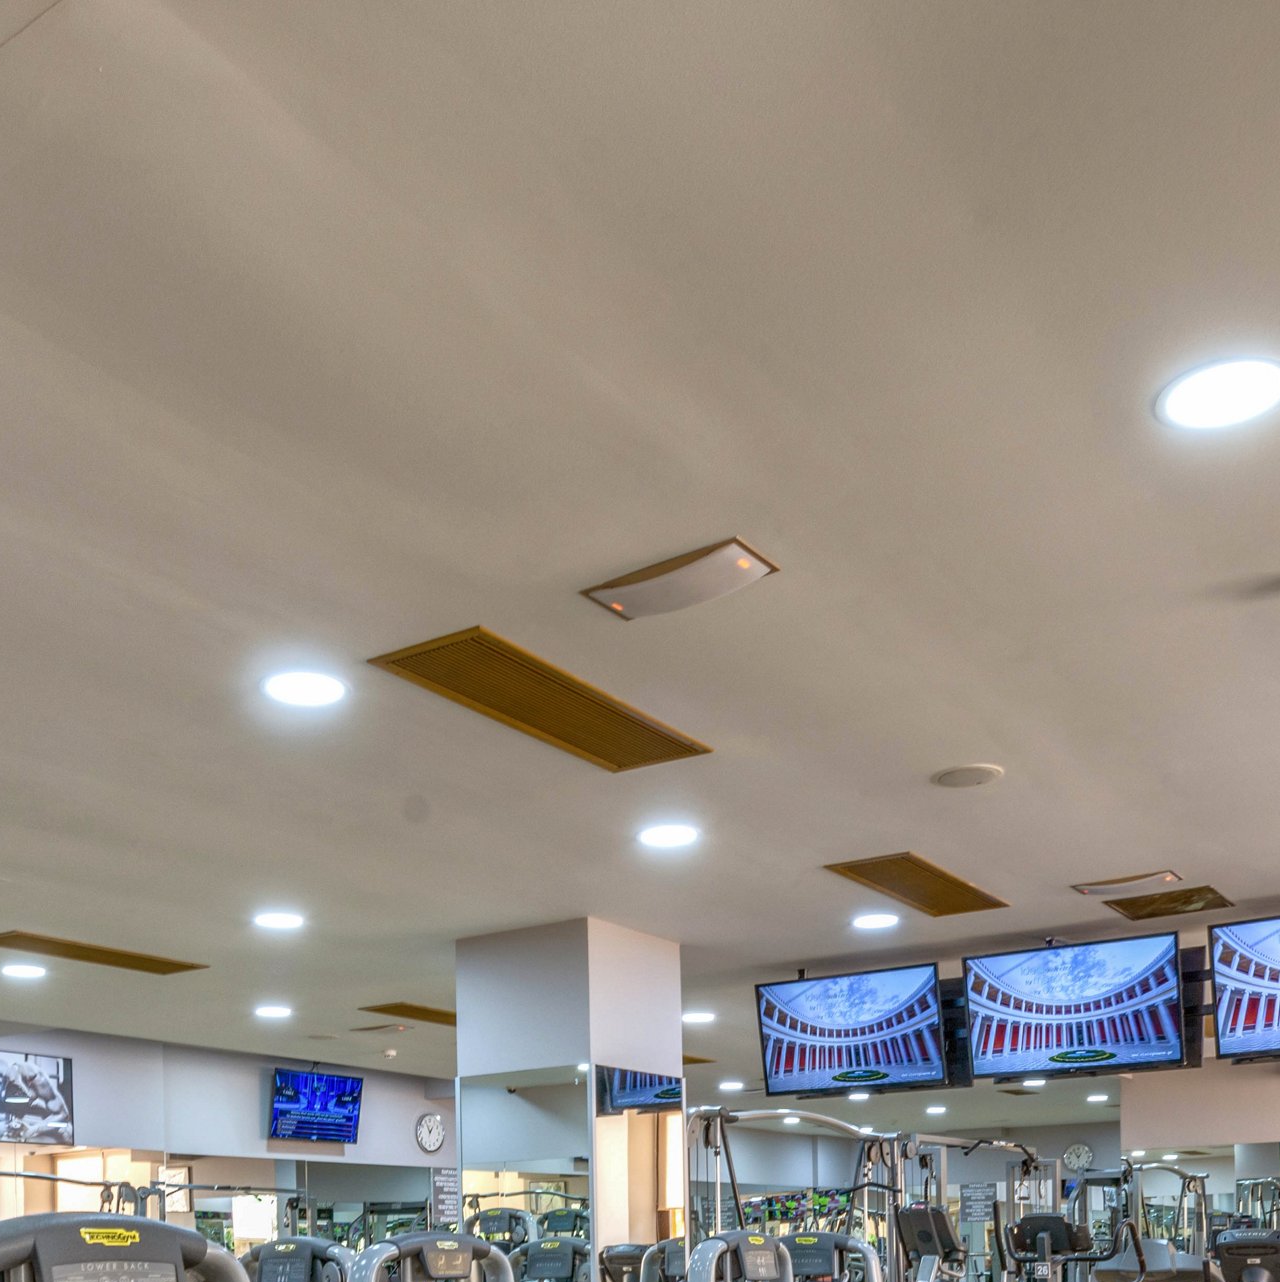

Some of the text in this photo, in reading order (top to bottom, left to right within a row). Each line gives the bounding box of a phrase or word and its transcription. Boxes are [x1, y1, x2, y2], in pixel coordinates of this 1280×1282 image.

[80, 1262, 150, 1272] LOWER BACK
[1037, 1266, 1048, 1275] 26
